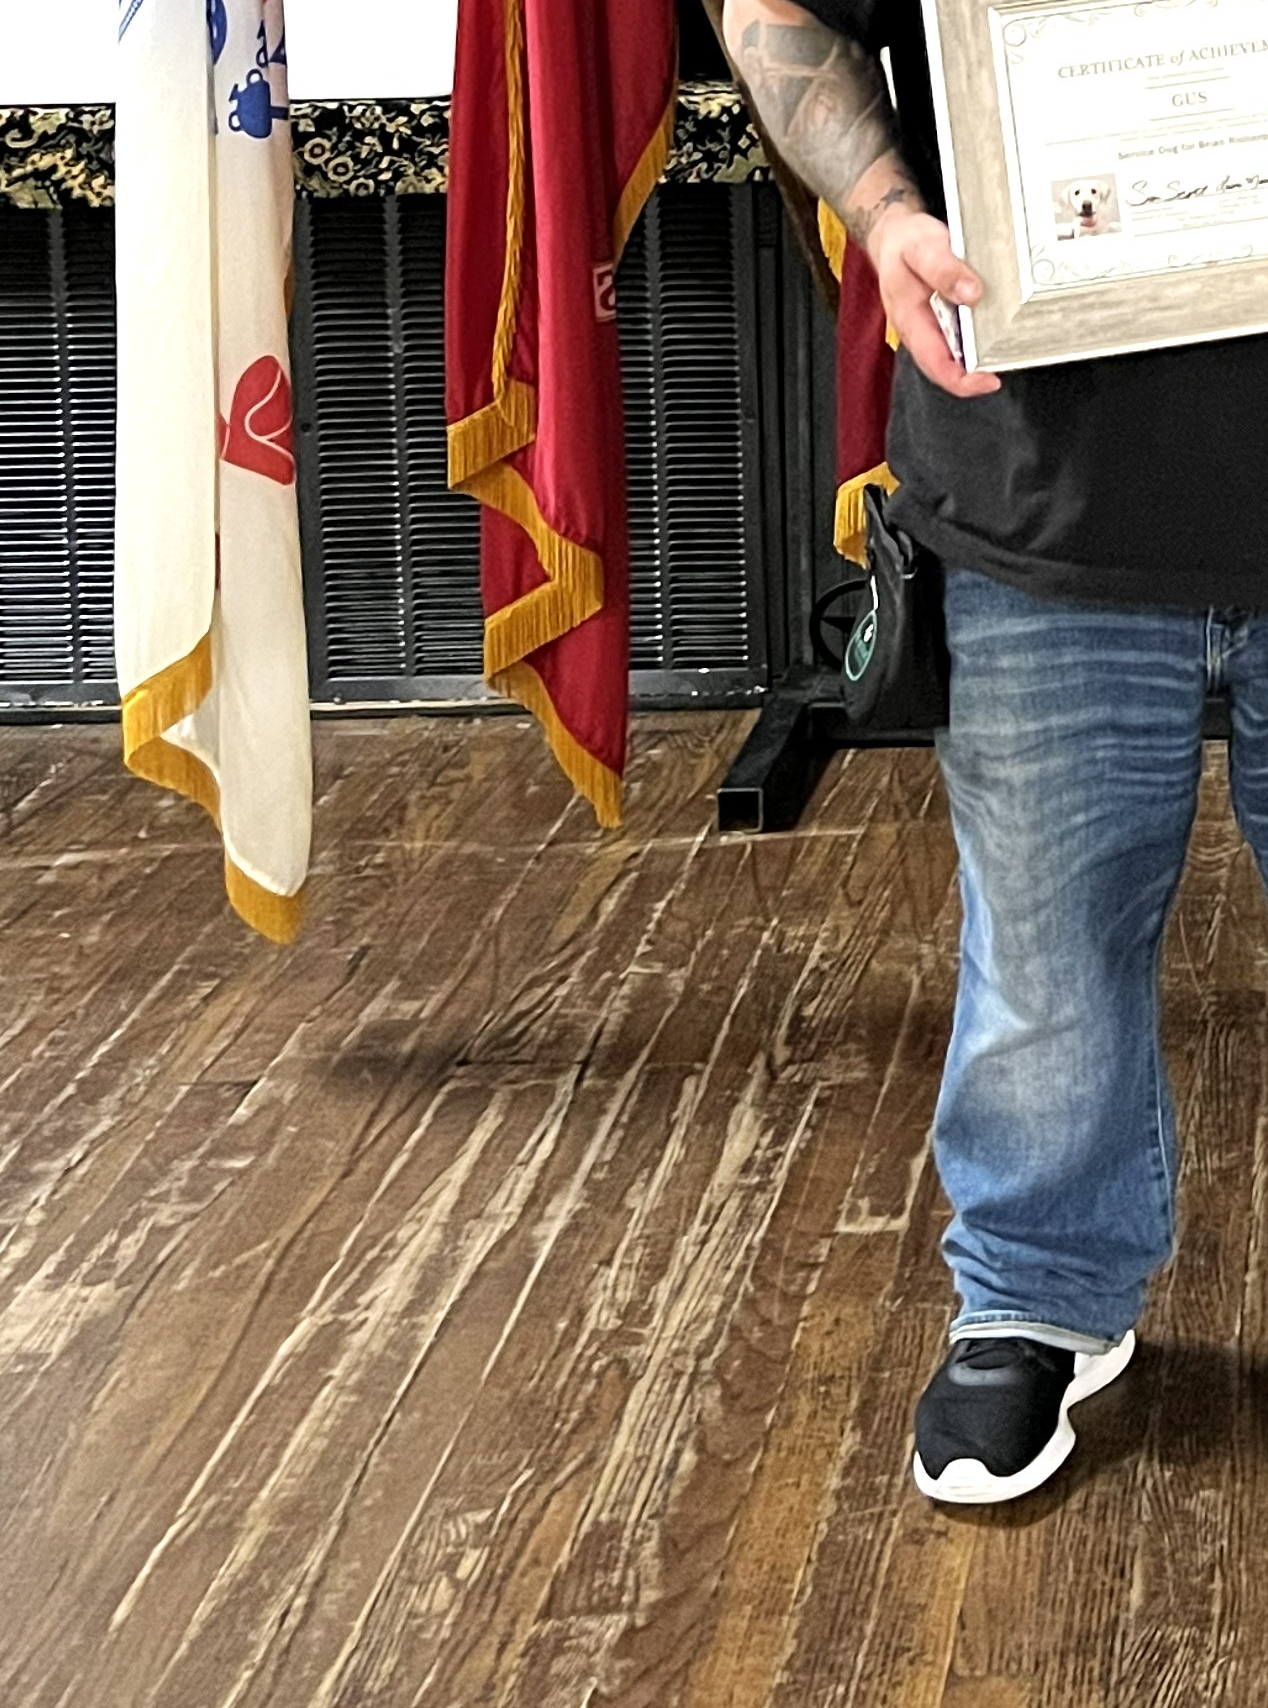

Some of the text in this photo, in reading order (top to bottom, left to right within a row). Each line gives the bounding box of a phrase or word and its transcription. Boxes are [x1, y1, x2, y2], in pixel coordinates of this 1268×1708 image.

[1057, 54, 1166, 79] CERTIFICATE
[1170, 50, 1184, 66] of
[1171, 91, 1208, 108] GUS
[1158, 145, 1179, 155] Dog
